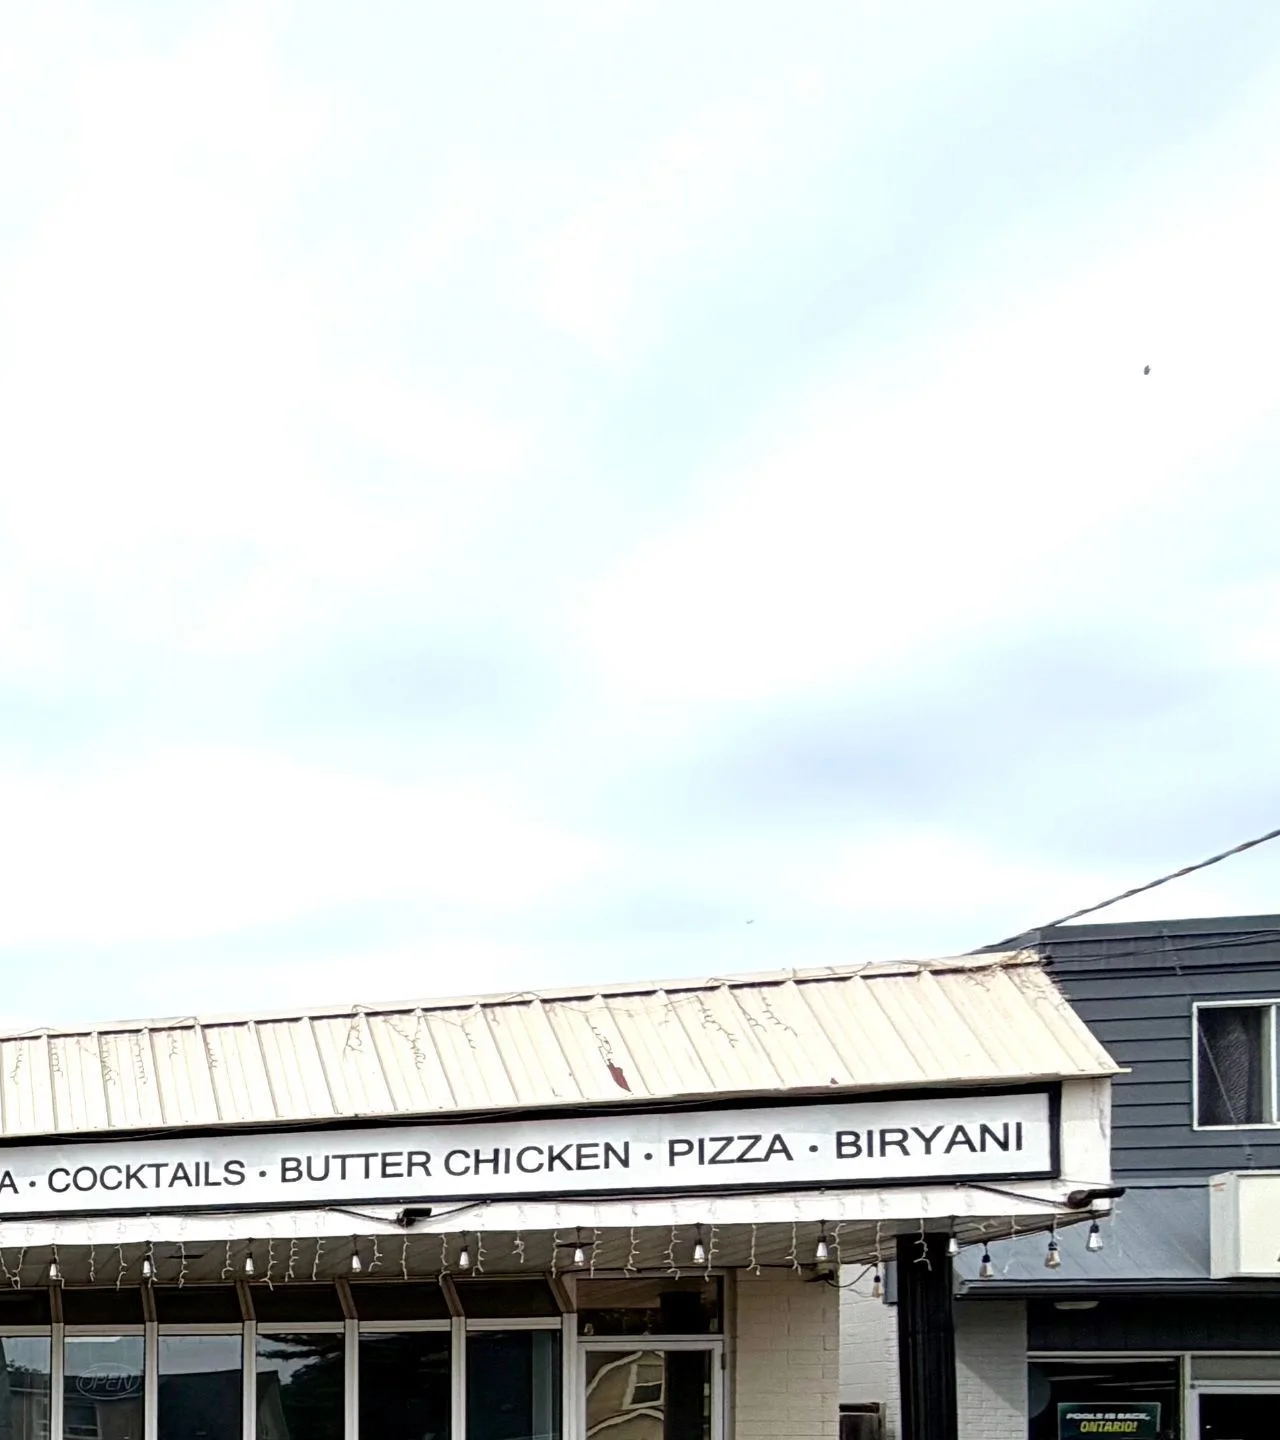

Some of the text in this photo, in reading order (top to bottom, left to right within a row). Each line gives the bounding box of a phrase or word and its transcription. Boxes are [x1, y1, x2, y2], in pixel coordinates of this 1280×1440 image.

[47, 1160, 246, 1193] COCKTAILS
[280, 1150, 432, 1183] BUTTER
[444, 1141, 631, 1177] CHICKEN
[668, 1133, 794, 1167] PIZZA
[835, 1121, 1023, 1159] BIRYANI
[80, 1372, 134, 1390] OPEN
[1080, 1421, 1138, 1433] ONTARIO!
